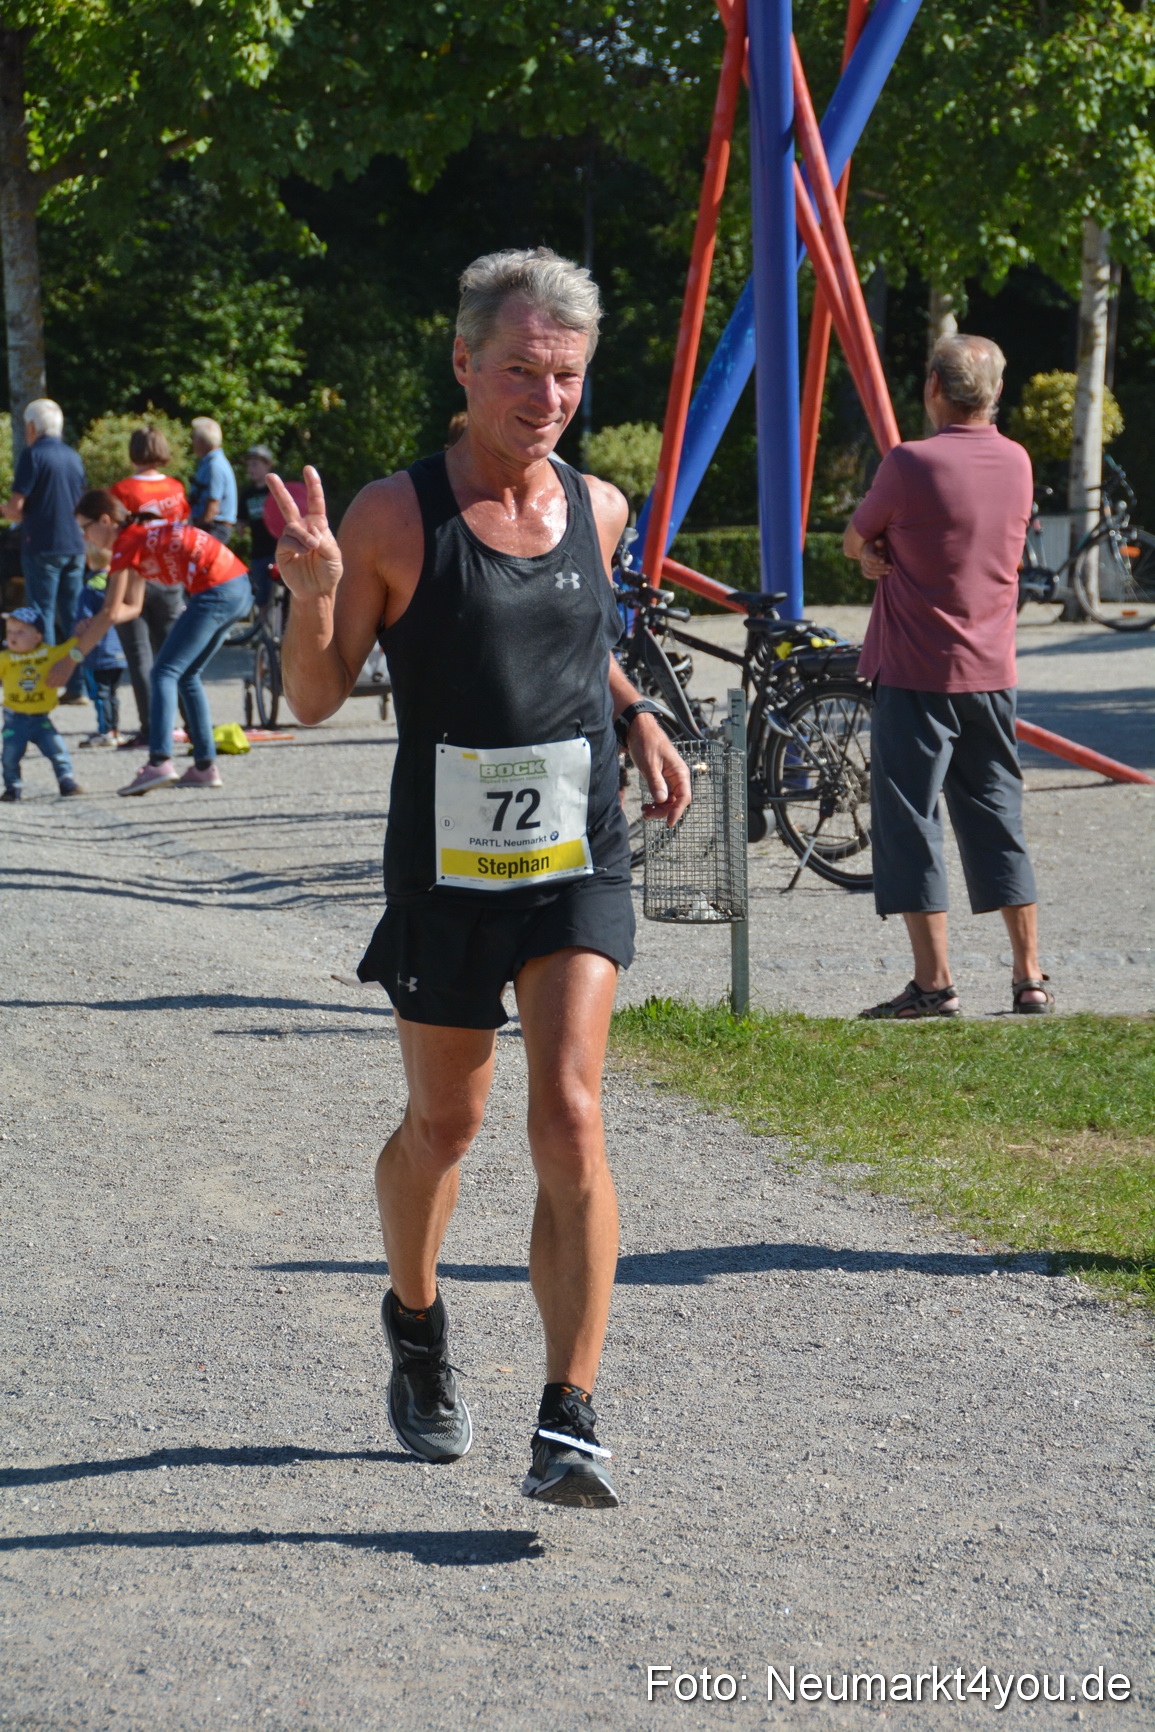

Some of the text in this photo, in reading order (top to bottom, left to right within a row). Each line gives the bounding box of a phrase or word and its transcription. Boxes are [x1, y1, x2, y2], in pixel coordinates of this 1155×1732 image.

[480, 760, 547, 778] BOCK
[486, 788, 541, 832] 72
[444, 819, 451, 828] D
[469, 835, 547, 848] PARTL Neumarkt
[477, 856, 550, 879] Stephan
